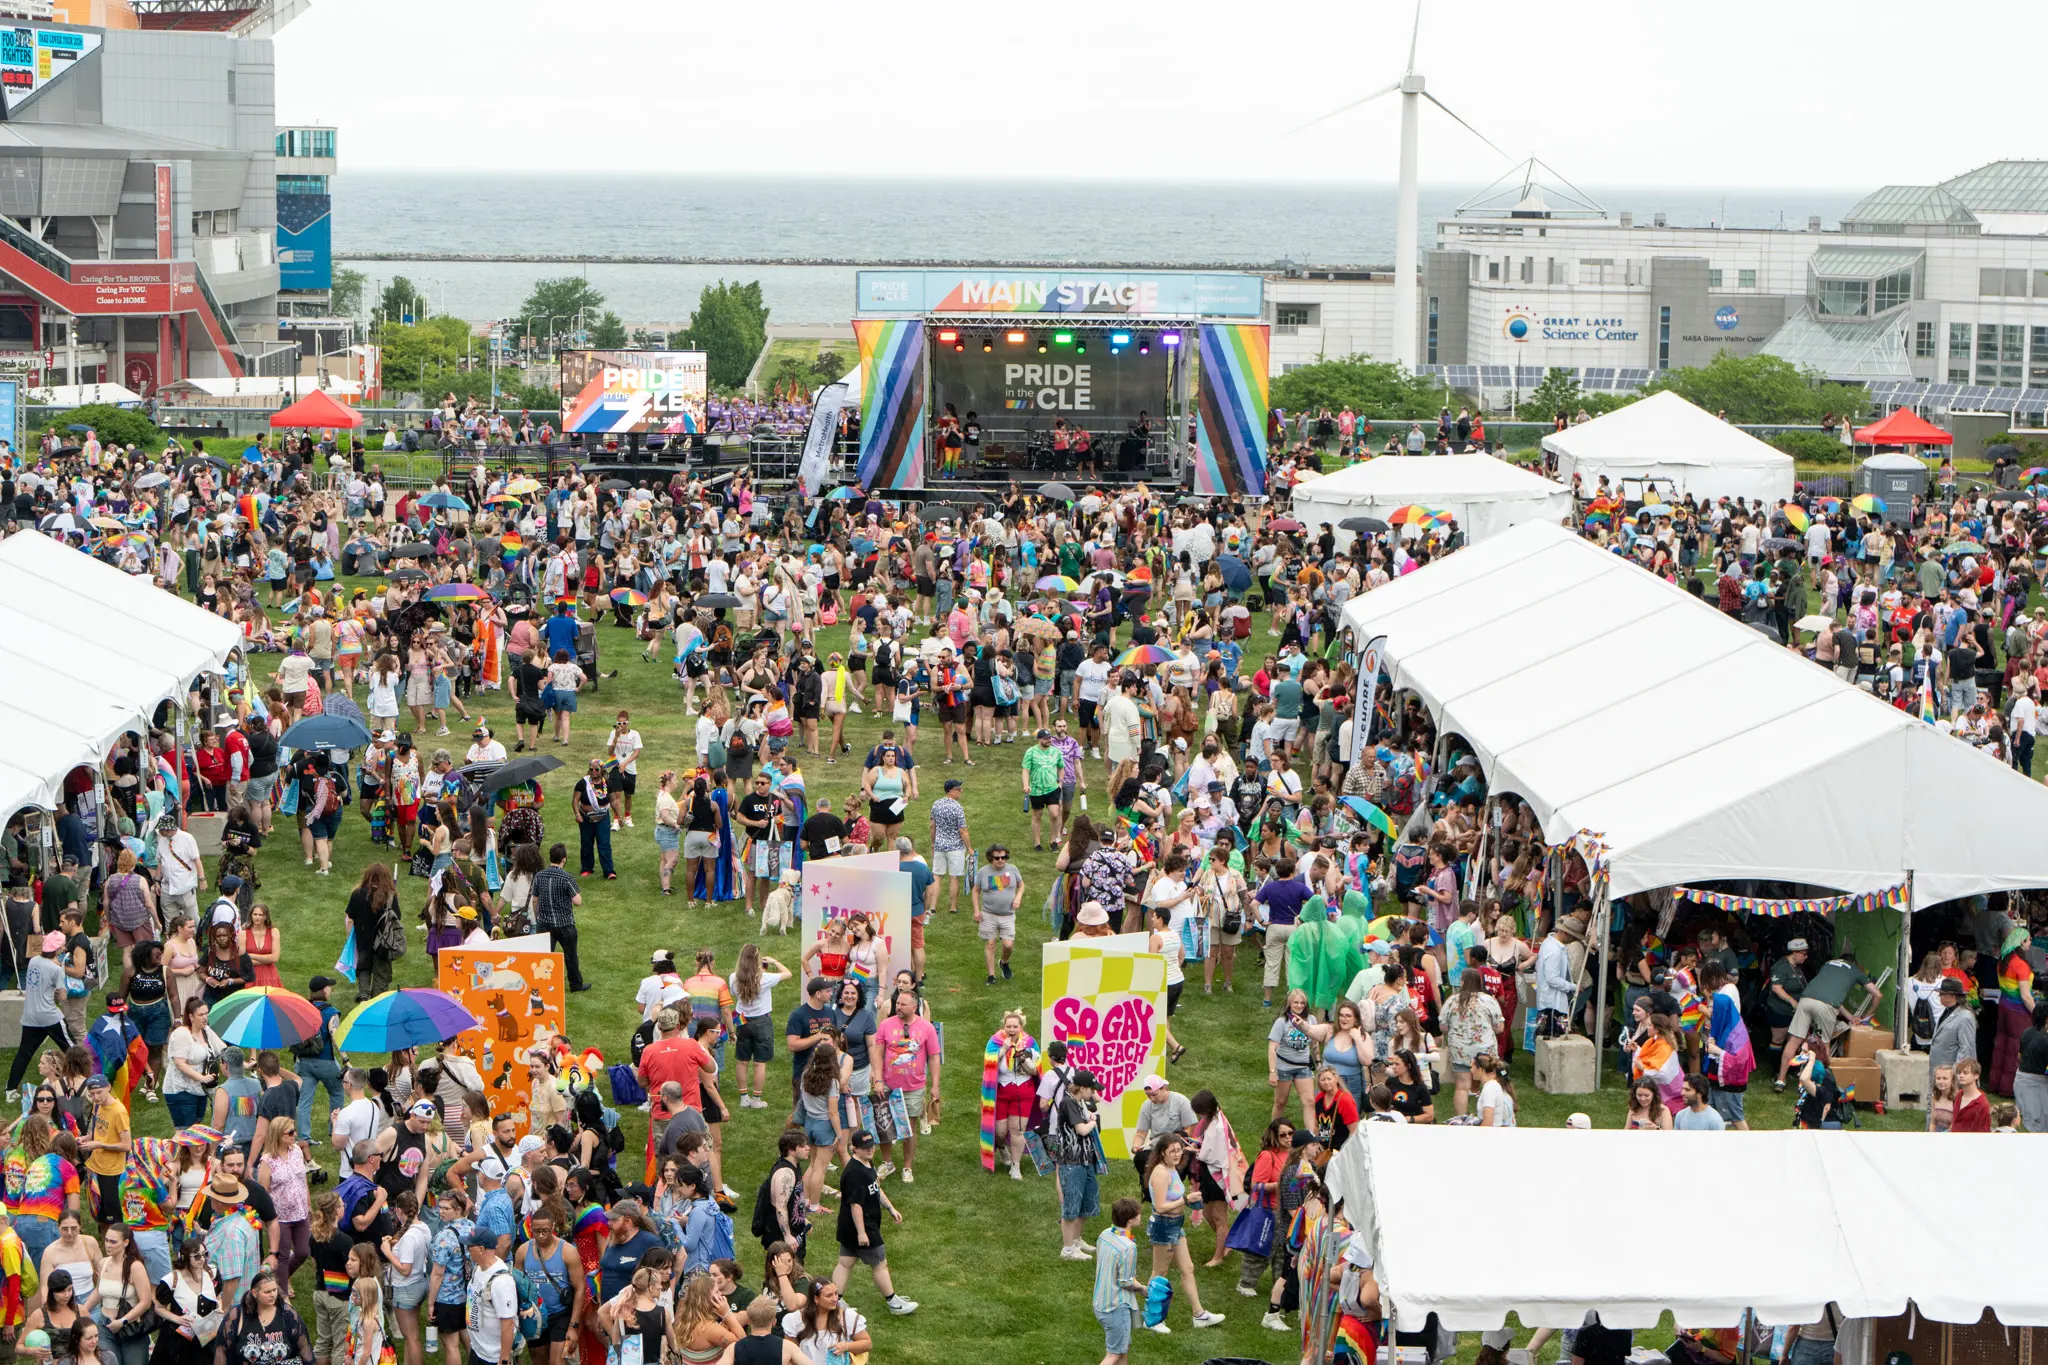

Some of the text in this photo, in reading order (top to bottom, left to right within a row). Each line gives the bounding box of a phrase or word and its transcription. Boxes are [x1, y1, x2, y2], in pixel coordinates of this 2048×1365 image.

[2, 32, 15, 47] FOO
[2, 48, 32, 64] FIGHTERS
[81, 275, 162, 284] Caring For The BROWNS.
[871, 281, 908, 291] PRIDE
[96, 286, 118, 294] Caring
[886, 291, 908, 301] CLE
[961, 280, 1158, 306] MAIN STAGE
[1543, 318, 1623, 326] GREAT LAKES
[1542, 327, 1639, 341] Science Center
[603, 368, 683, 389] PRIDE
[1005, 363, 1091, 386] PRIDE
[603, 391, 630, 400] in the
[1005, 387, 1034, 398] in the
[1036, 387, 1091, 410] CLE
[815, 410, 834, 459] MetroHealth
[1893, 480, 1907, 488] ARIS
[1054, 998, 1154, 1044] SO GAY
[1067, 1041, 1148, 1068] FOR EACH
